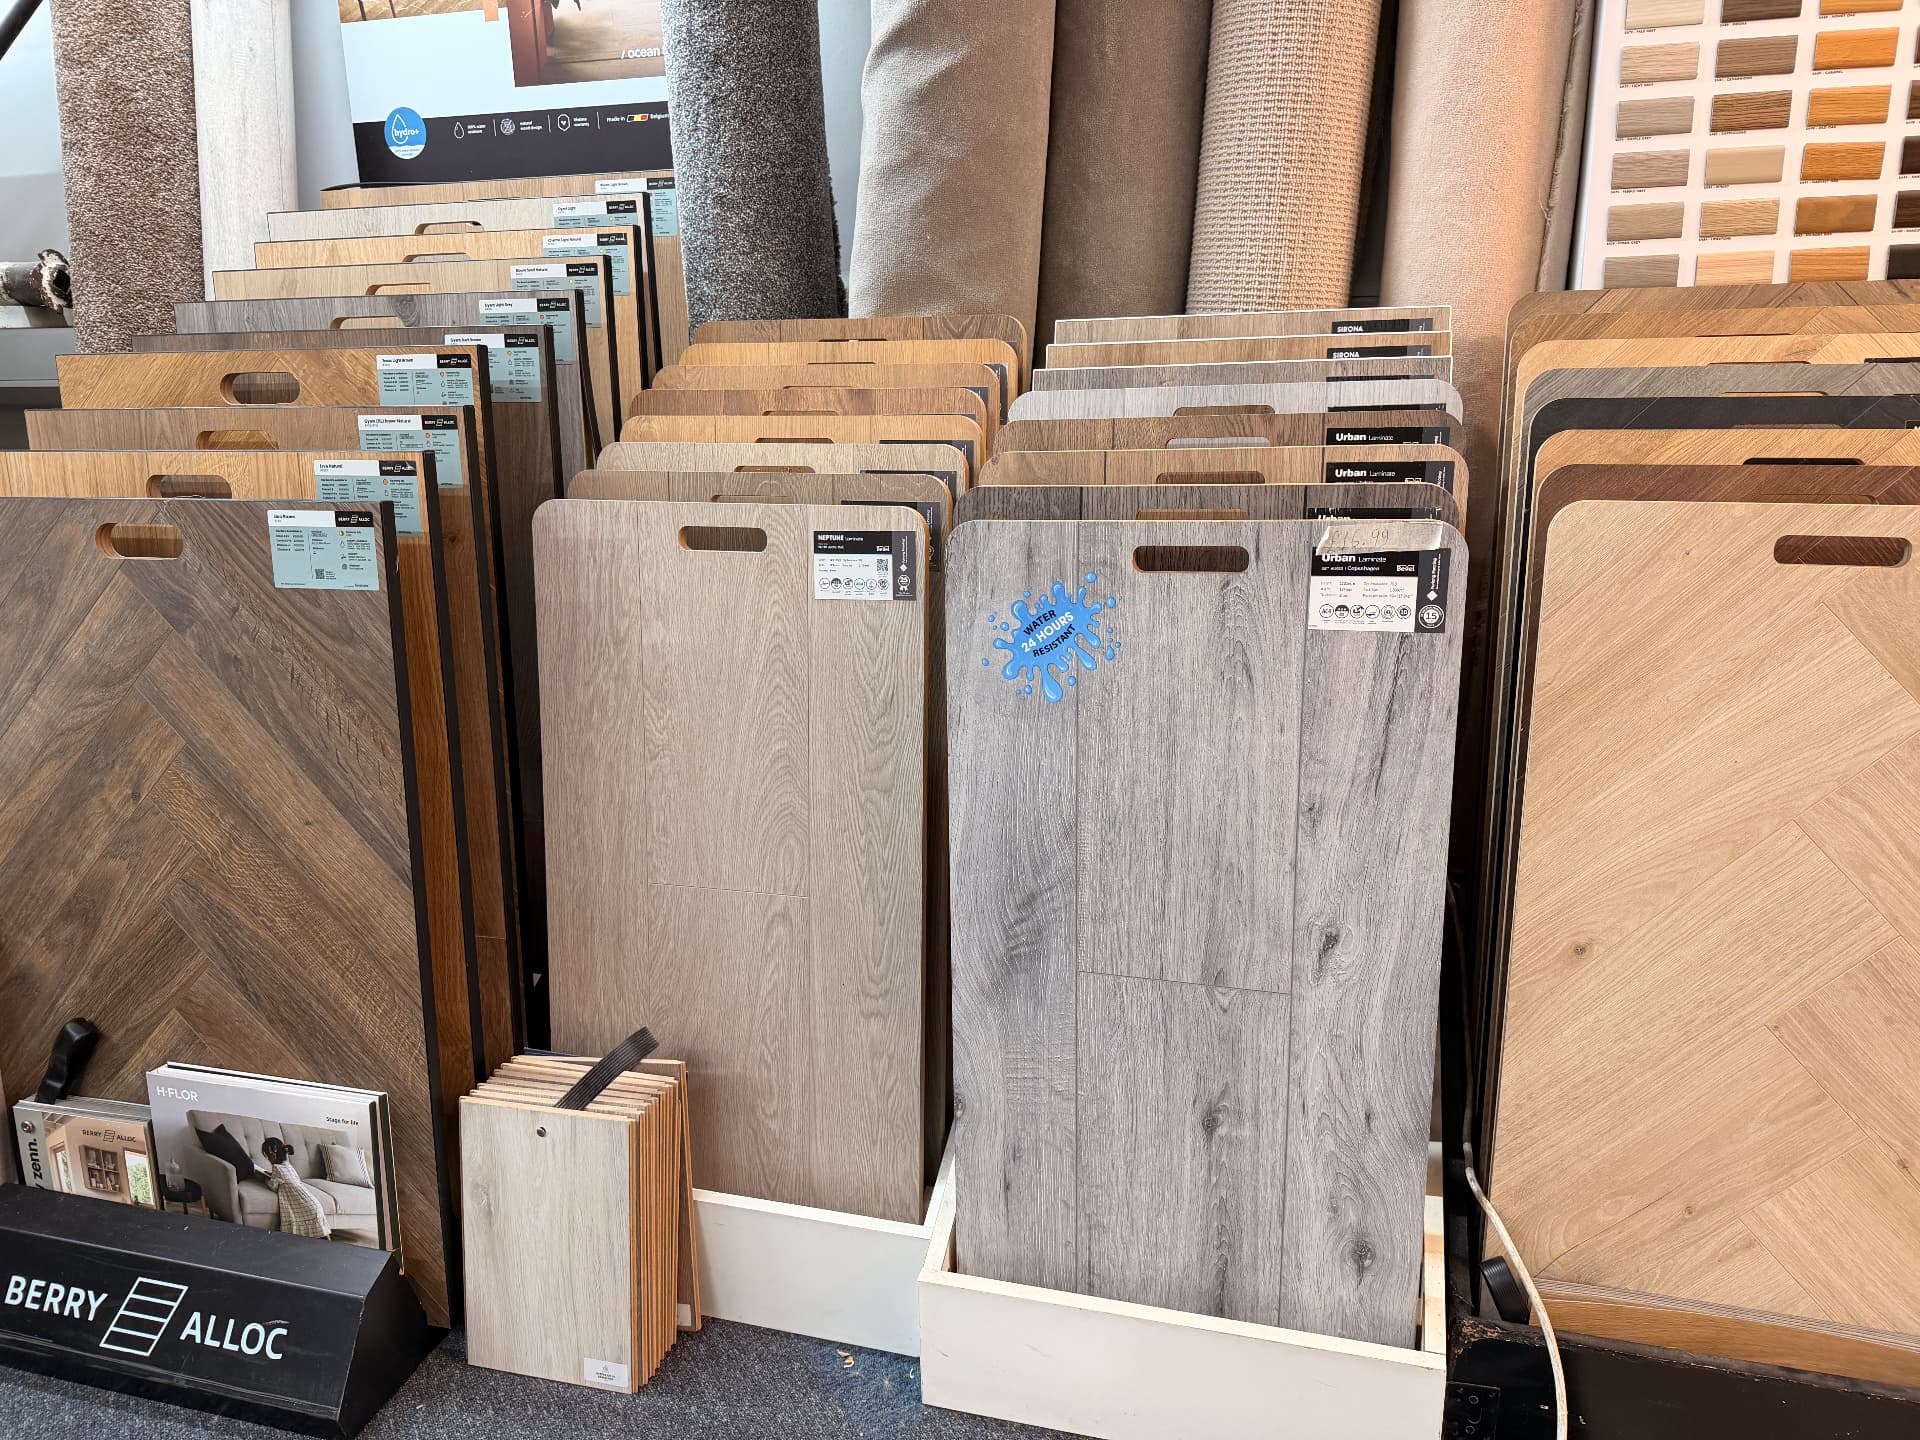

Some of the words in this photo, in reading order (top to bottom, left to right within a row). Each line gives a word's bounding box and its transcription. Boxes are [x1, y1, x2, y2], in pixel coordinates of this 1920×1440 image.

[394, 126, 420, 138] hydro+
[1337, 325, 1364, 333] SIRONA
[1332, 351, 1360, 359] SIRONA
[1335, 432, 1367, 442] Urban
[1334, 468, 1367, 478] Urban
[1321, 553, 1356, 563] Urban
[1396, 564, 1415, 572] Bevel
[1425, 612, 1437, 620] 15
[1023, 609, 1057, 636] WATER
[1021, 638, 1037, 653] 24
[1035, 611, 1074, 642] HOURS
[1032, 623, 1076, 657] RESISTANT
[82, 1129, 102, 1137] BERRY
[116, 1134, 137, 1142] ALLOC
[27, 1138, 43, 1180] zenn.
[4, 1274, 109, 1322] BERRY
[179, 1311, 289, 1361] ALLOC
